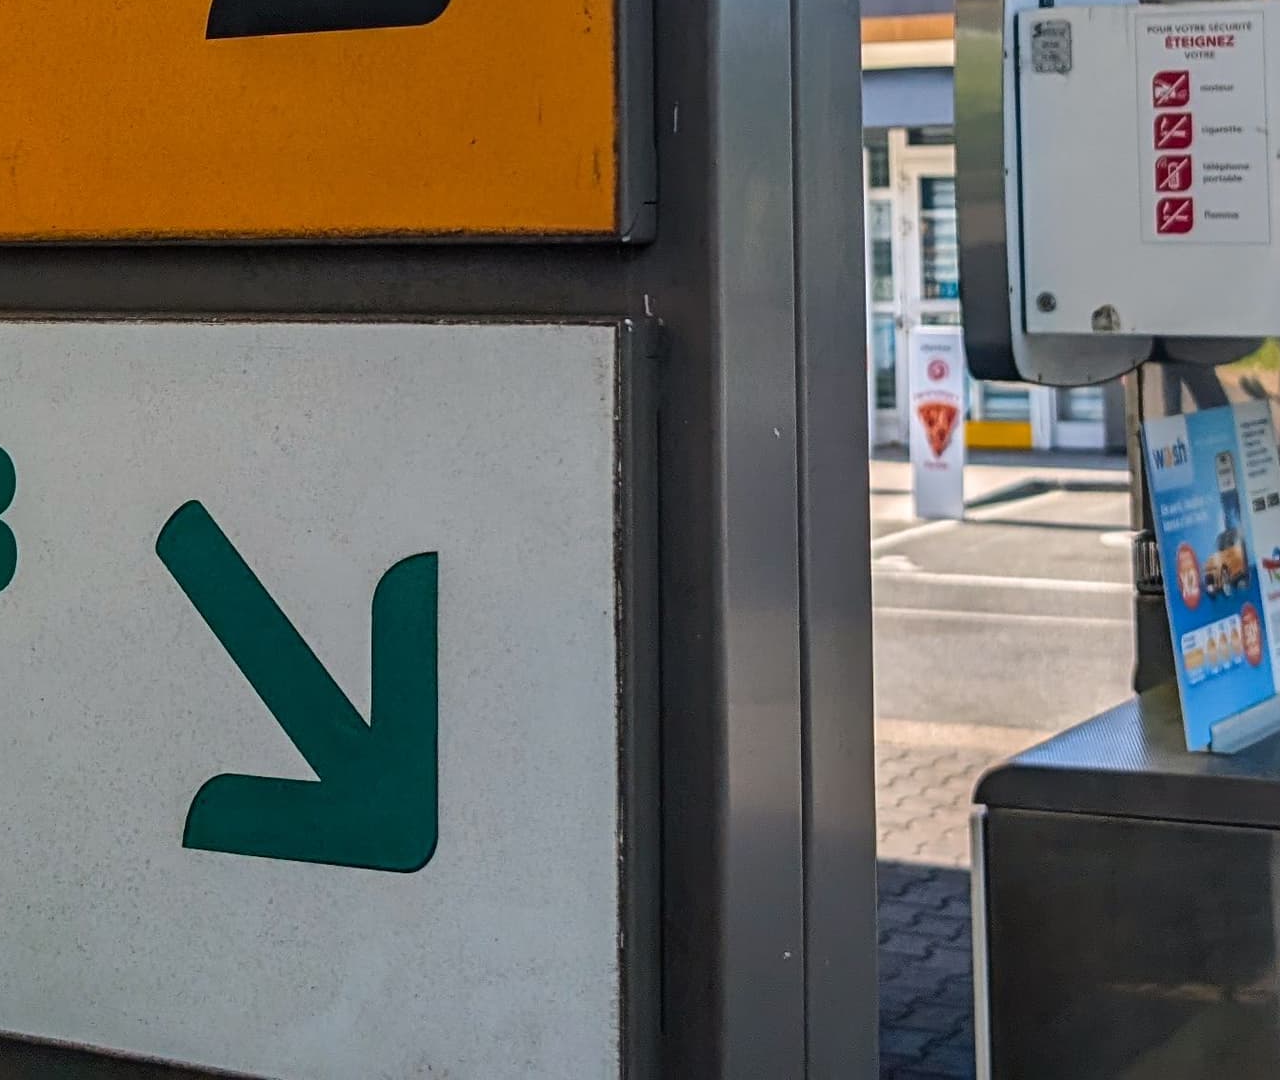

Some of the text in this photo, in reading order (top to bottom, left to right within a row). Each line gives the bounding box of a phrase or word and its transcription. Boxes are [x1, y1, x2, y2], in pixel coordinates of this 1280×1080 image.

[1146, 20, 1253, 34] POUR VOTRE SÉCURITÉ
[1165, 34, 1235, 50] ÉTEIGNEZ
[1184, 51, 1216, 60] VOTRE
